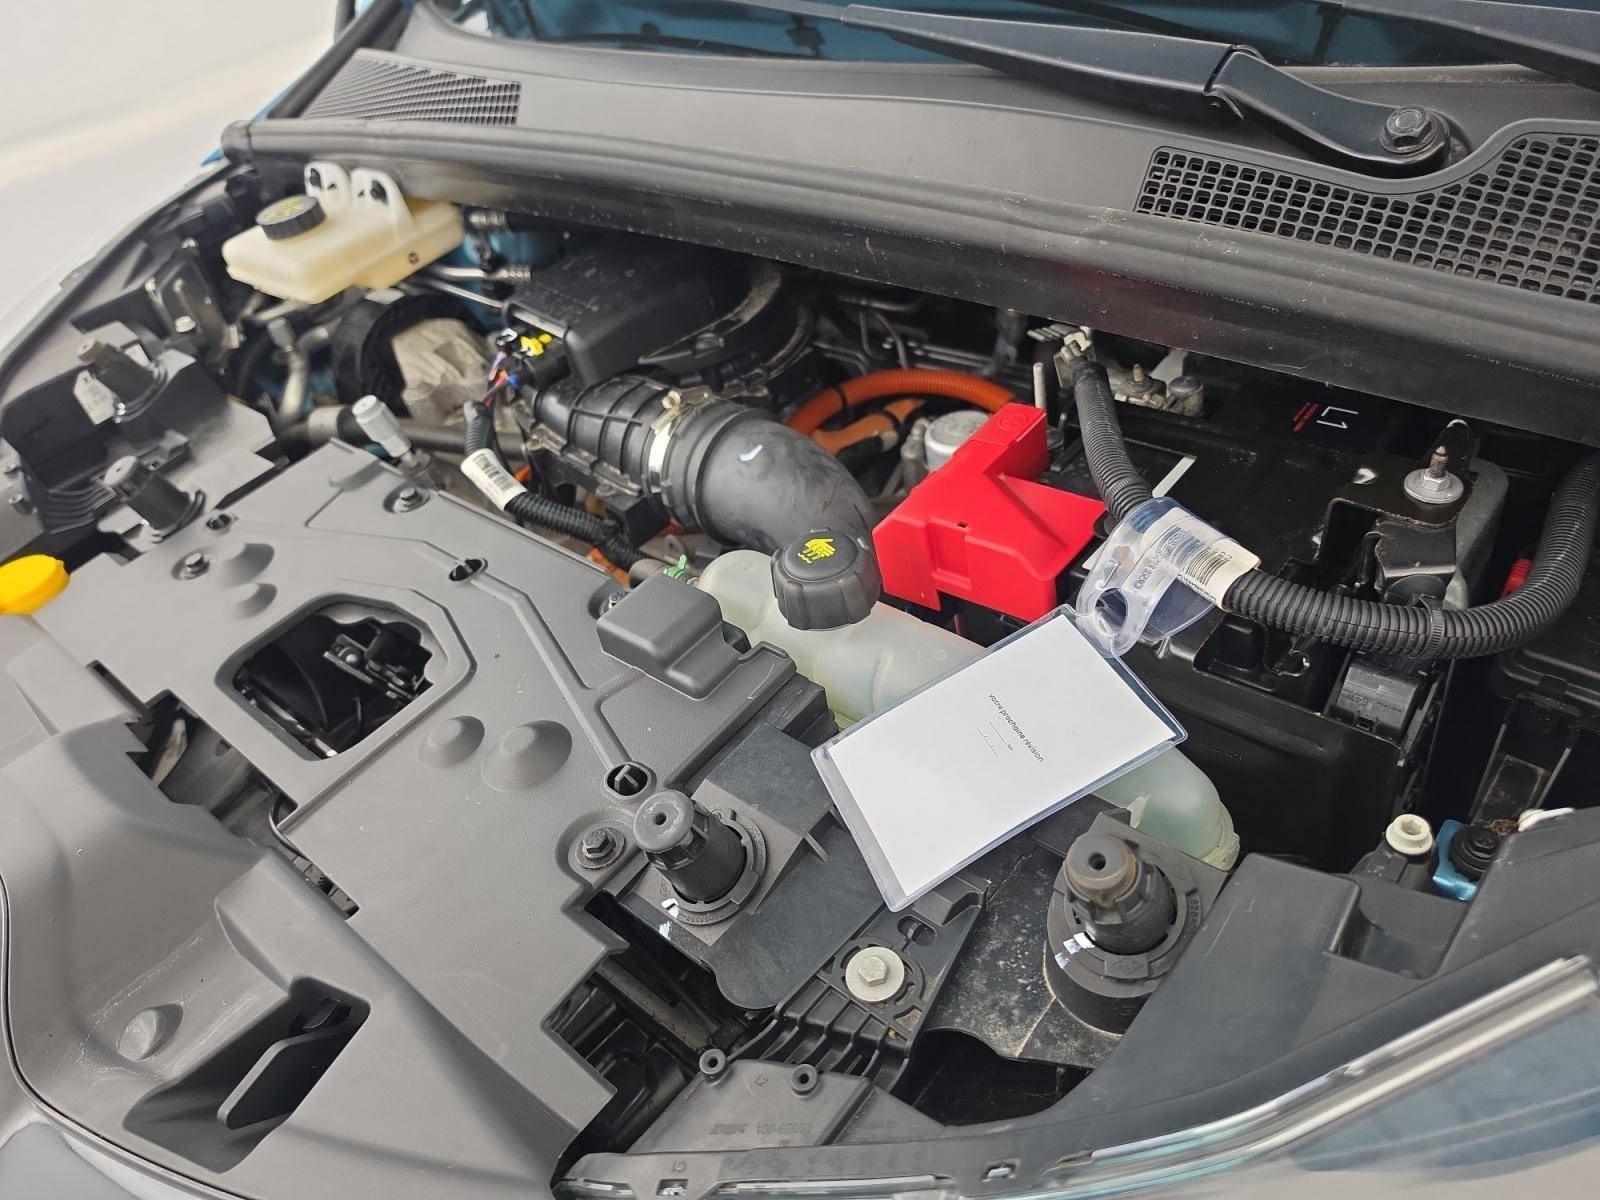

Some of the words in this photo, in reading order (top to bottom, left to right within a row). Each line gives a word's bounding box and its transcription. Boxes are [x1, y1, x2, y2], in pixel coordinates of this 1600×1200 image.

[988, 693, 1003, 711] votre
[999, 709, 1026, 740] prochaine
[1022, 737, 1044, 763] révision
